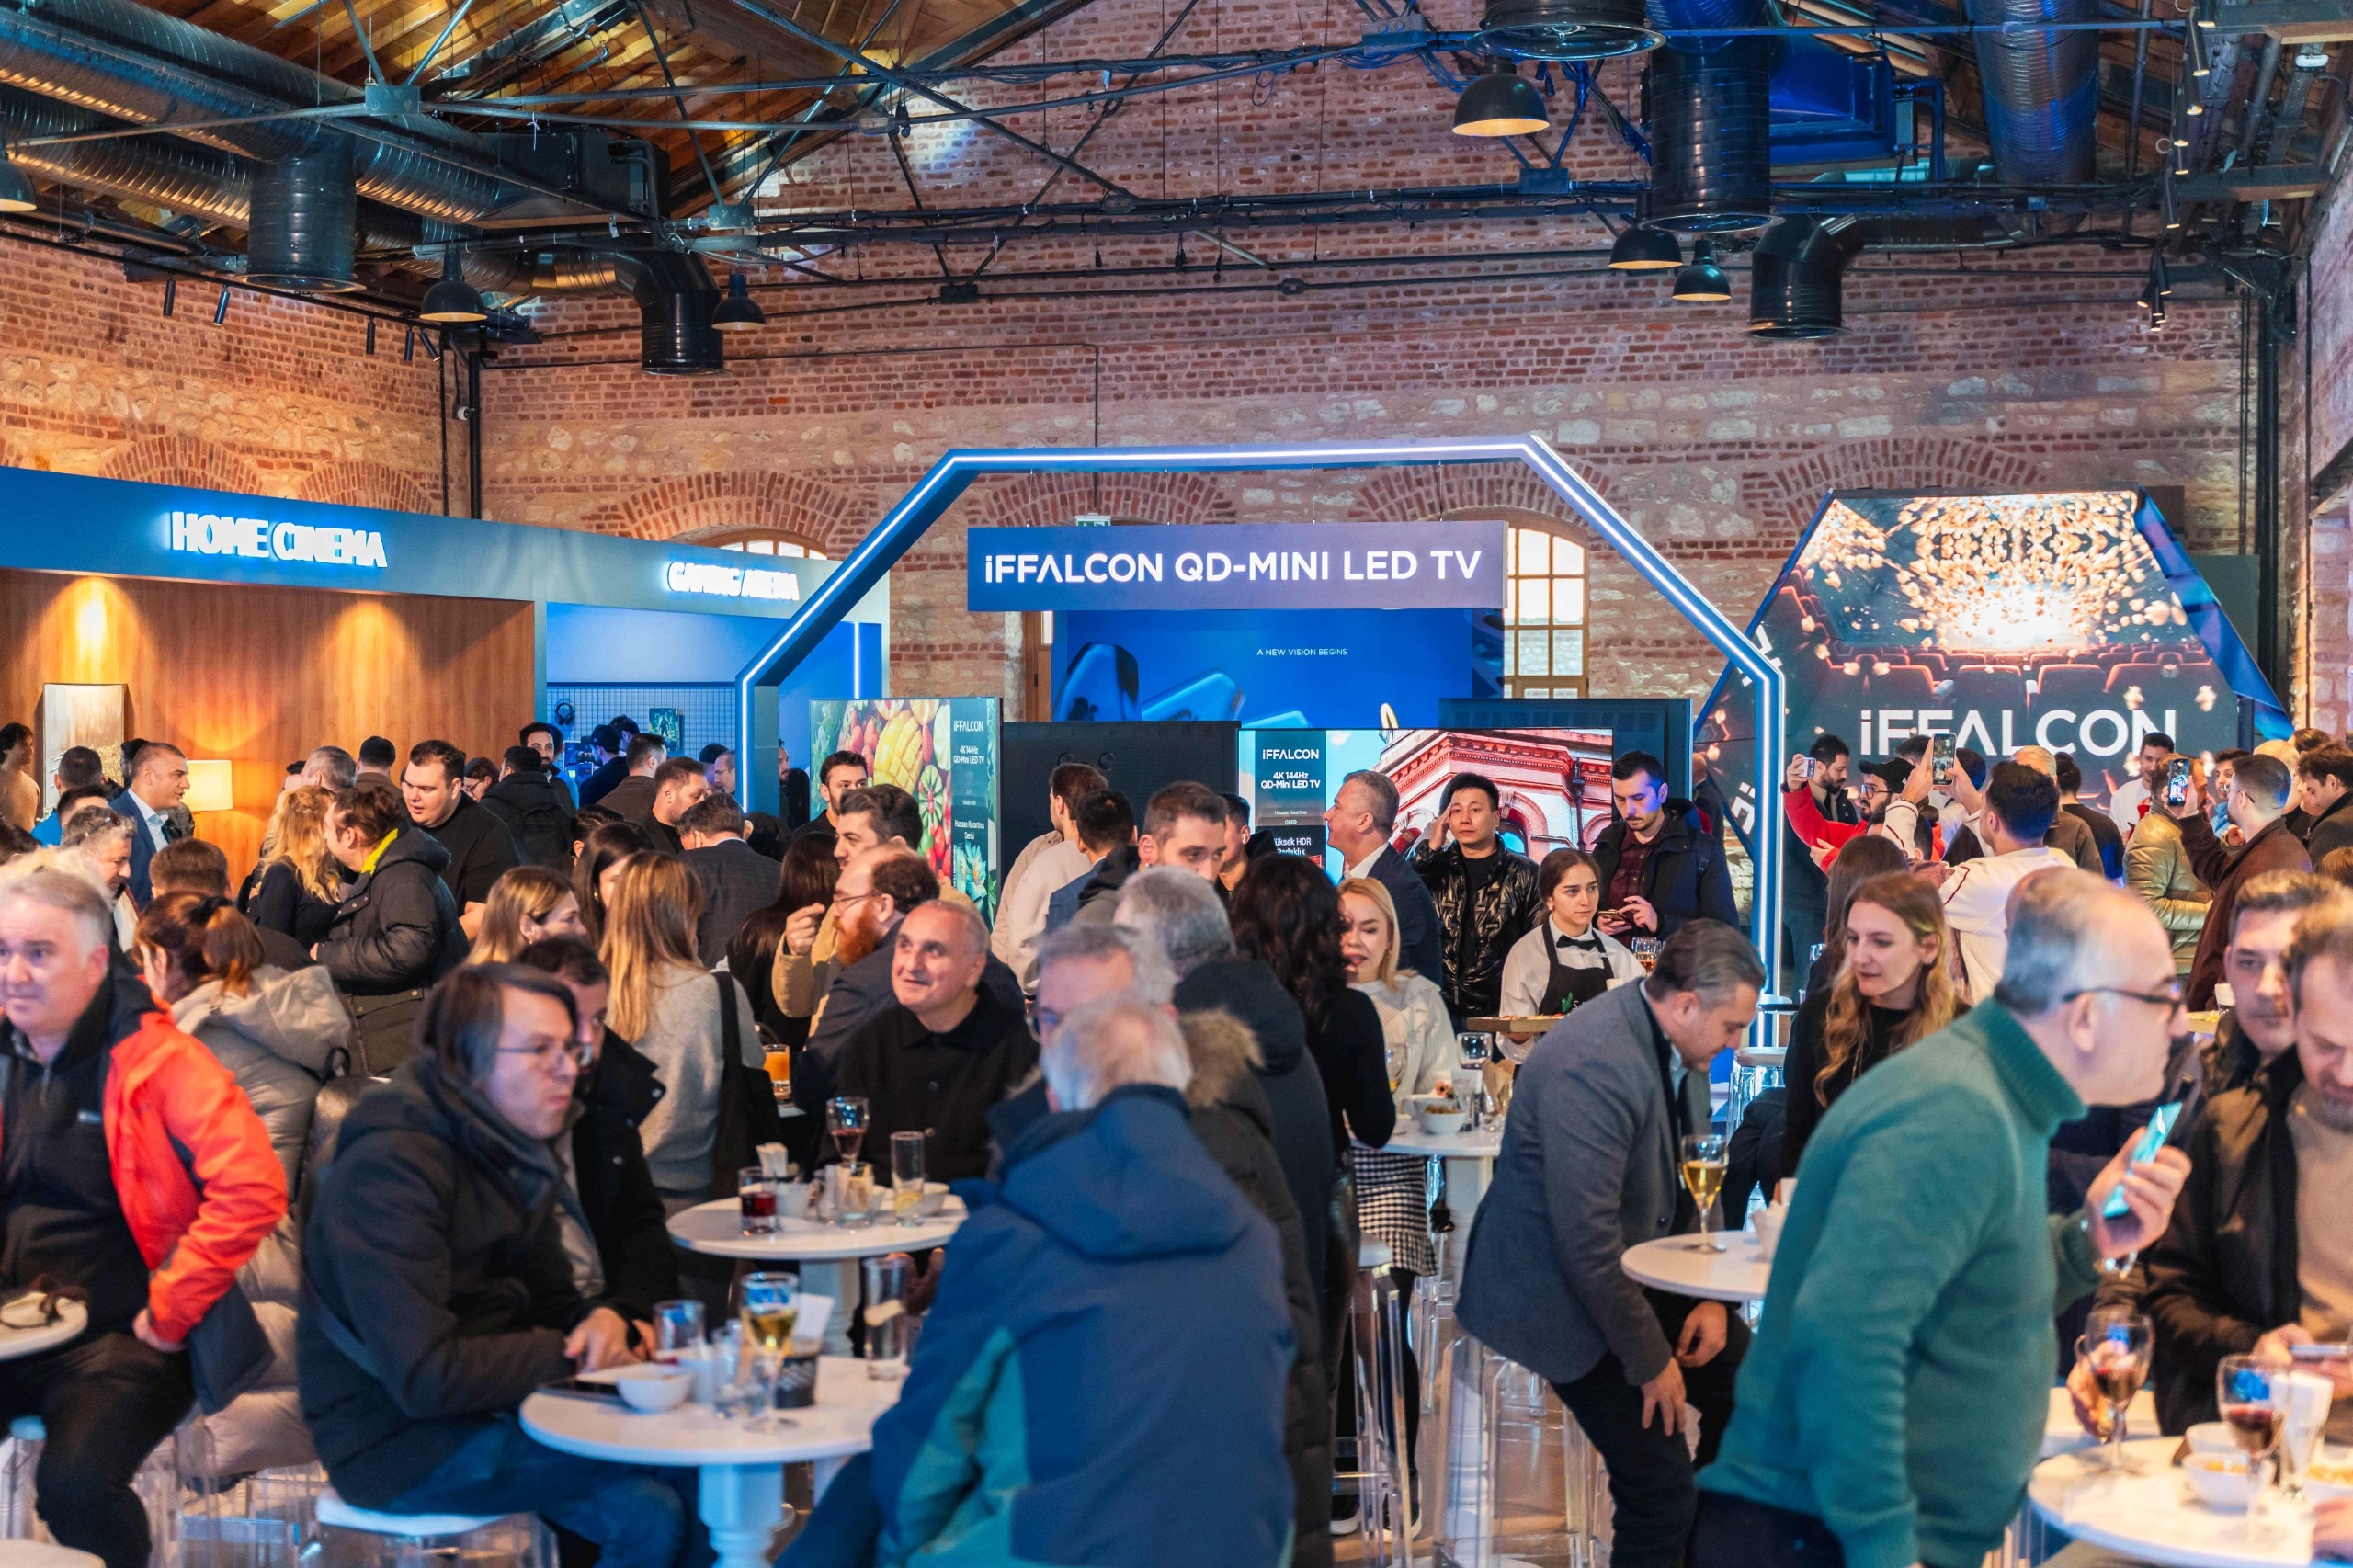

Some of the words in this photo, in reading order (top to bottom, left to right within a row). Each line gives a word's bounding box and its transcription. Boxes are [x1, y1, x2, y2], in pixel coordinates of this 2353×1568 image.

[172, 511, 269, 558] HOME
[273, 522, 388, 568] CINEMA
[985, 553, 1163, 583] iFFALCON
[1175, 551, 1328, 582] QD-MINI
[1344, 551, 1418, 580] LED
[1430, 550, 1483, 580] TV
[953, 720, 983, 733] iFFALCON
[1860, 710, 2177, 756] iFFALCON
[1262, 749, 1320, 760] iFFALCON
[970, 756, 979, 765] LED
[979, 756, 985, 765] TV
[1273, 771, 1285, 779] 4K
[1286, 771, 1309, 779] 144Hz
[1260, 780, 1291, 789] QD-Mini
[1292, 780, 1309, 789] LED
[1310, 780, 1321, 789] TV
[1274, 837, 1295, 846] üksek
[1296, 837, 1312, 846] HDR
